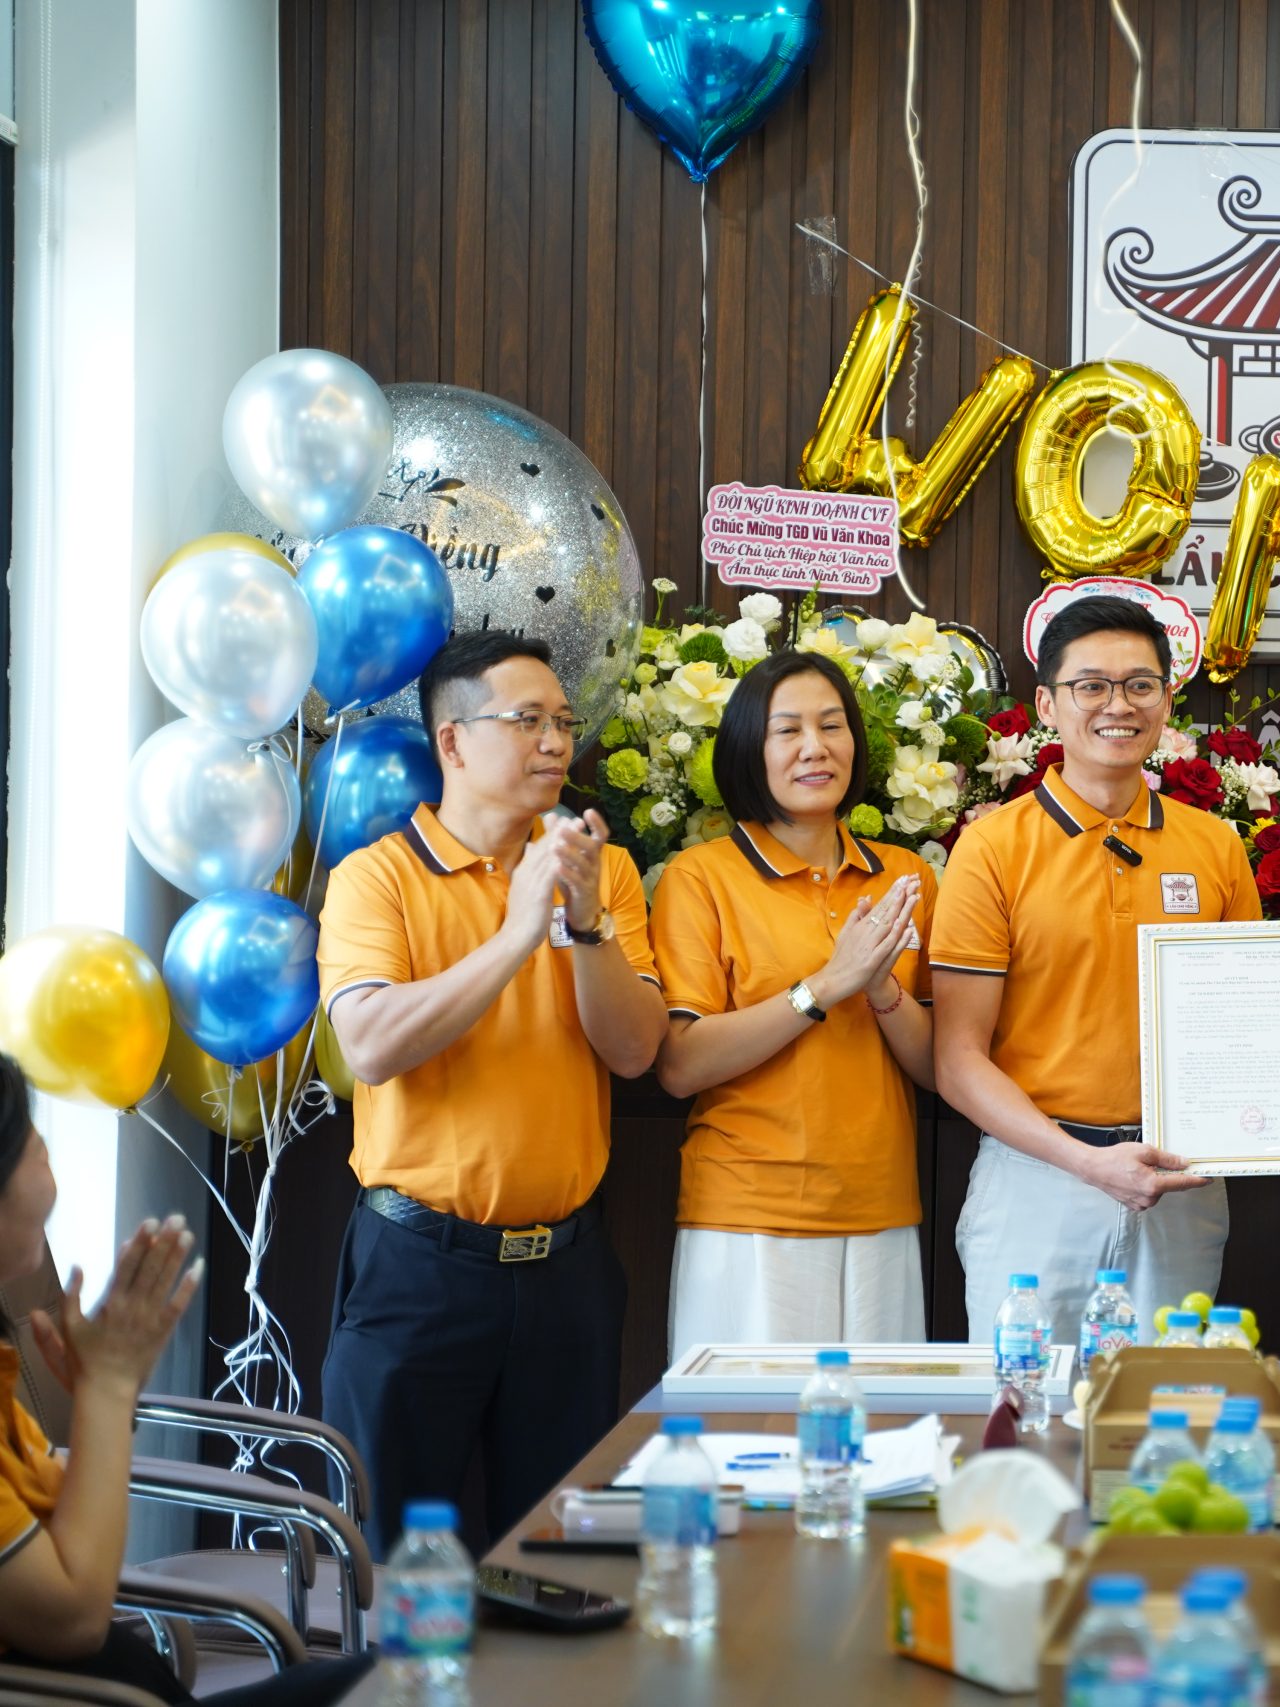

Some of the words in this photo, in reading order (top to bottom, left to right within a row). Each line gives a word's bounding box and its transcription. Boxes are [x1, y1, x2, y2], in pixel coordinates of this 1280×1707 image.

[717, 490, 742, 513] ĐỘI
[743, 494, 774, 515] NGŨ
[775, 498, 810, 516] KINH
[811, 501, 860, 520] DOANH
[711, 517, 744, 534] Chúc
[746, 520, 783, 540] Mừng
[812, 525, 828, 541] Vũ
[831, 527, 855, 544] Văn
[857, 529, 890, 547] Khoa
[710, 540, 736, 555] Phó
[737, 543, 762, 557] Chủ
[763, 546, 786, 561] tịch
[788, 546, 817, 564] Hiệp
[818, 550, 837, 566] hội
[839, 551, 864, 565] Văn
[865, 553, 890, 568] hóa
[727, 557, 751, 576] Ẩm
[753, 564, 780, 580] thực
[782, 566, 807, 580] tỉnh
[808, 568, 840, 583] Ninh
[841, 570, 872, 585] Bình
